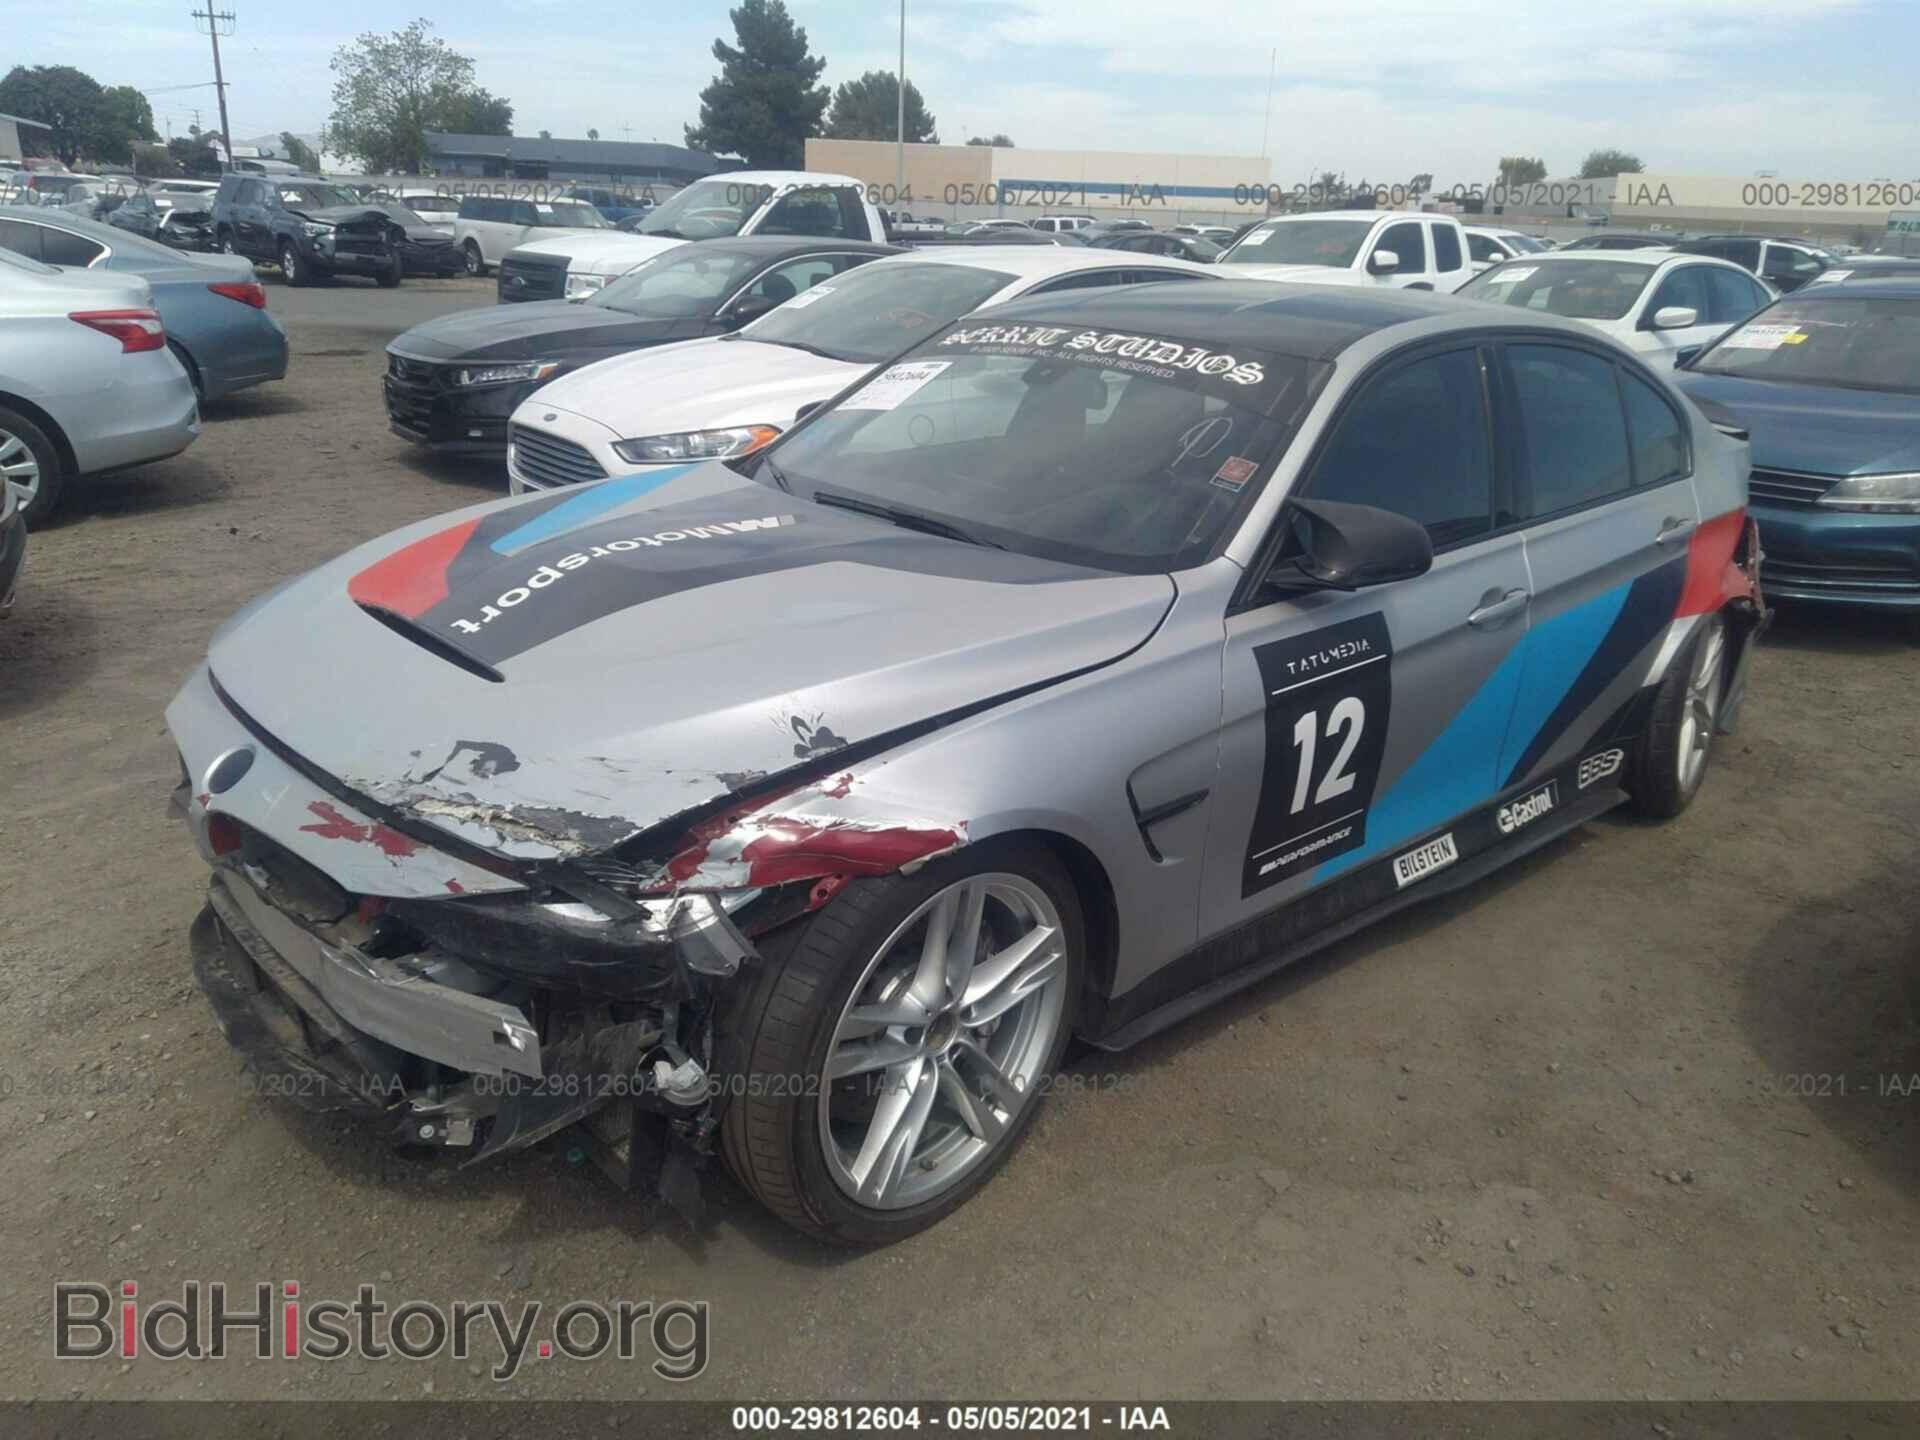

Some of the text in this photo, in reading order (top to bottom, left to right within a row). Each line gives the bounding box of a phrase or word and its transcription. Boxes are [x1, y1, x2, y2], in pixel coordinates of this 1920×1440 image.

[1064, 330, 1265, 386] STUDIOS
[1289, 696, 1366, 815] 12
[1511, 787, 1553, 828] Castrol
[1398, 838, 1453, 879] BILSTEIN
